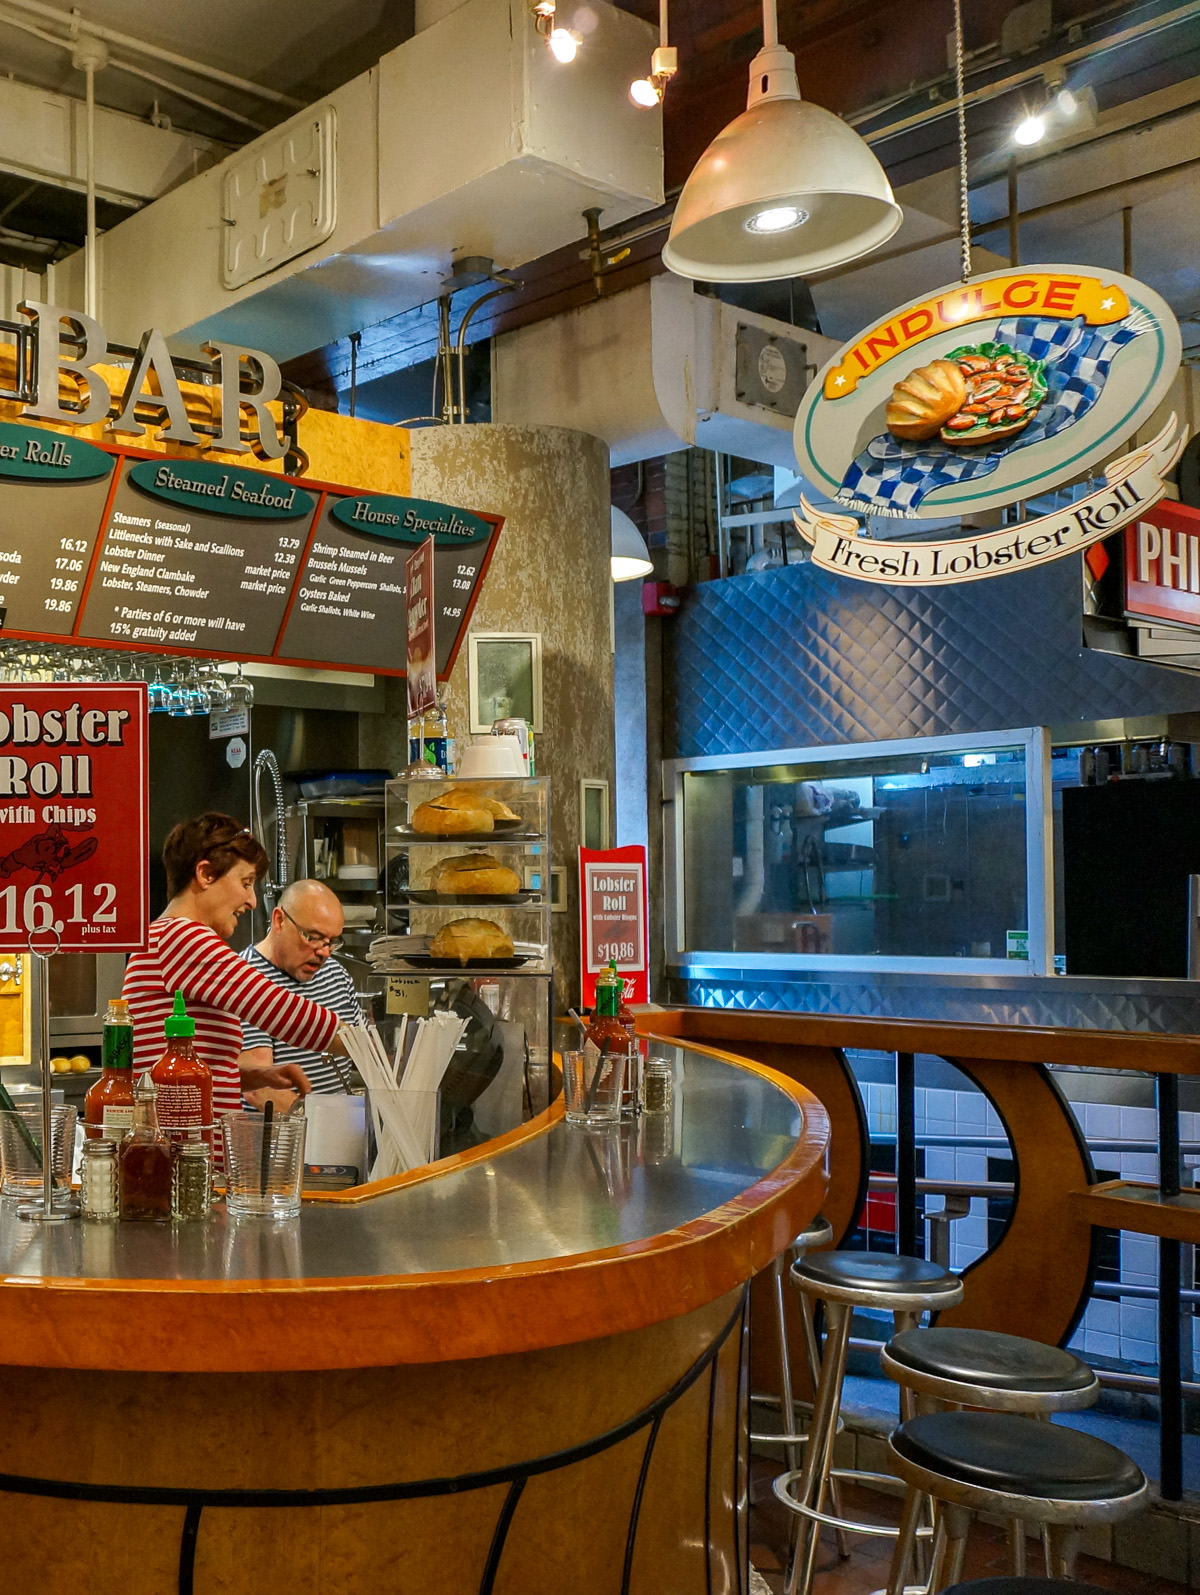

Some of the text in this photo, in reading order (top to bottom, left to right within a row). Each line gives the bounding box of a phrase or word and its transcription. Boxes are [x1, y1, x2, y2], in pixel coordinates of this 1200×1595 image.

[852, 280, 1082, 371] INDULGE
[17, 300, 291, 461] BAR
[24, 439, 72, 467] Rolls
[155, 466, 296, 510] Steamed Seafood
[113, 512, 191, 534] Steamers (seasonal)
[352, 502, 475, 537] House Specialties
[829, 478, 1145, 577] Fresh Lobster Roll
[60, 537, 88, 552] 16.12
[109, 529, 245, 557] Littlenecks with Sake and Scallions
[278, 536, 300, 549] 13.79
[105, 545, 165, 563] Lobster Dinner
[274, 552, 296, 565] 12.38
[312, 543, 395, 565] Shrimp Steamed in Beer
[55, 558, 83, 572] 17.06
[100, 561, 195, 583] New England Clambake
[308, 558, 367, 575] Brussels Mussels
[50, 578, 78, 592] 19.86
[299, 588, 350, 603] Oysters Baked
[442, 607, 461, 617] 14.95
[42, 806, 97, 826] Chips
[593, 876, 635, 892] Lobster
[603, 896, 626, 911] Roll
[82, 925, 117, 936] plus tax
[598, 942, 634, 962] $19.86
